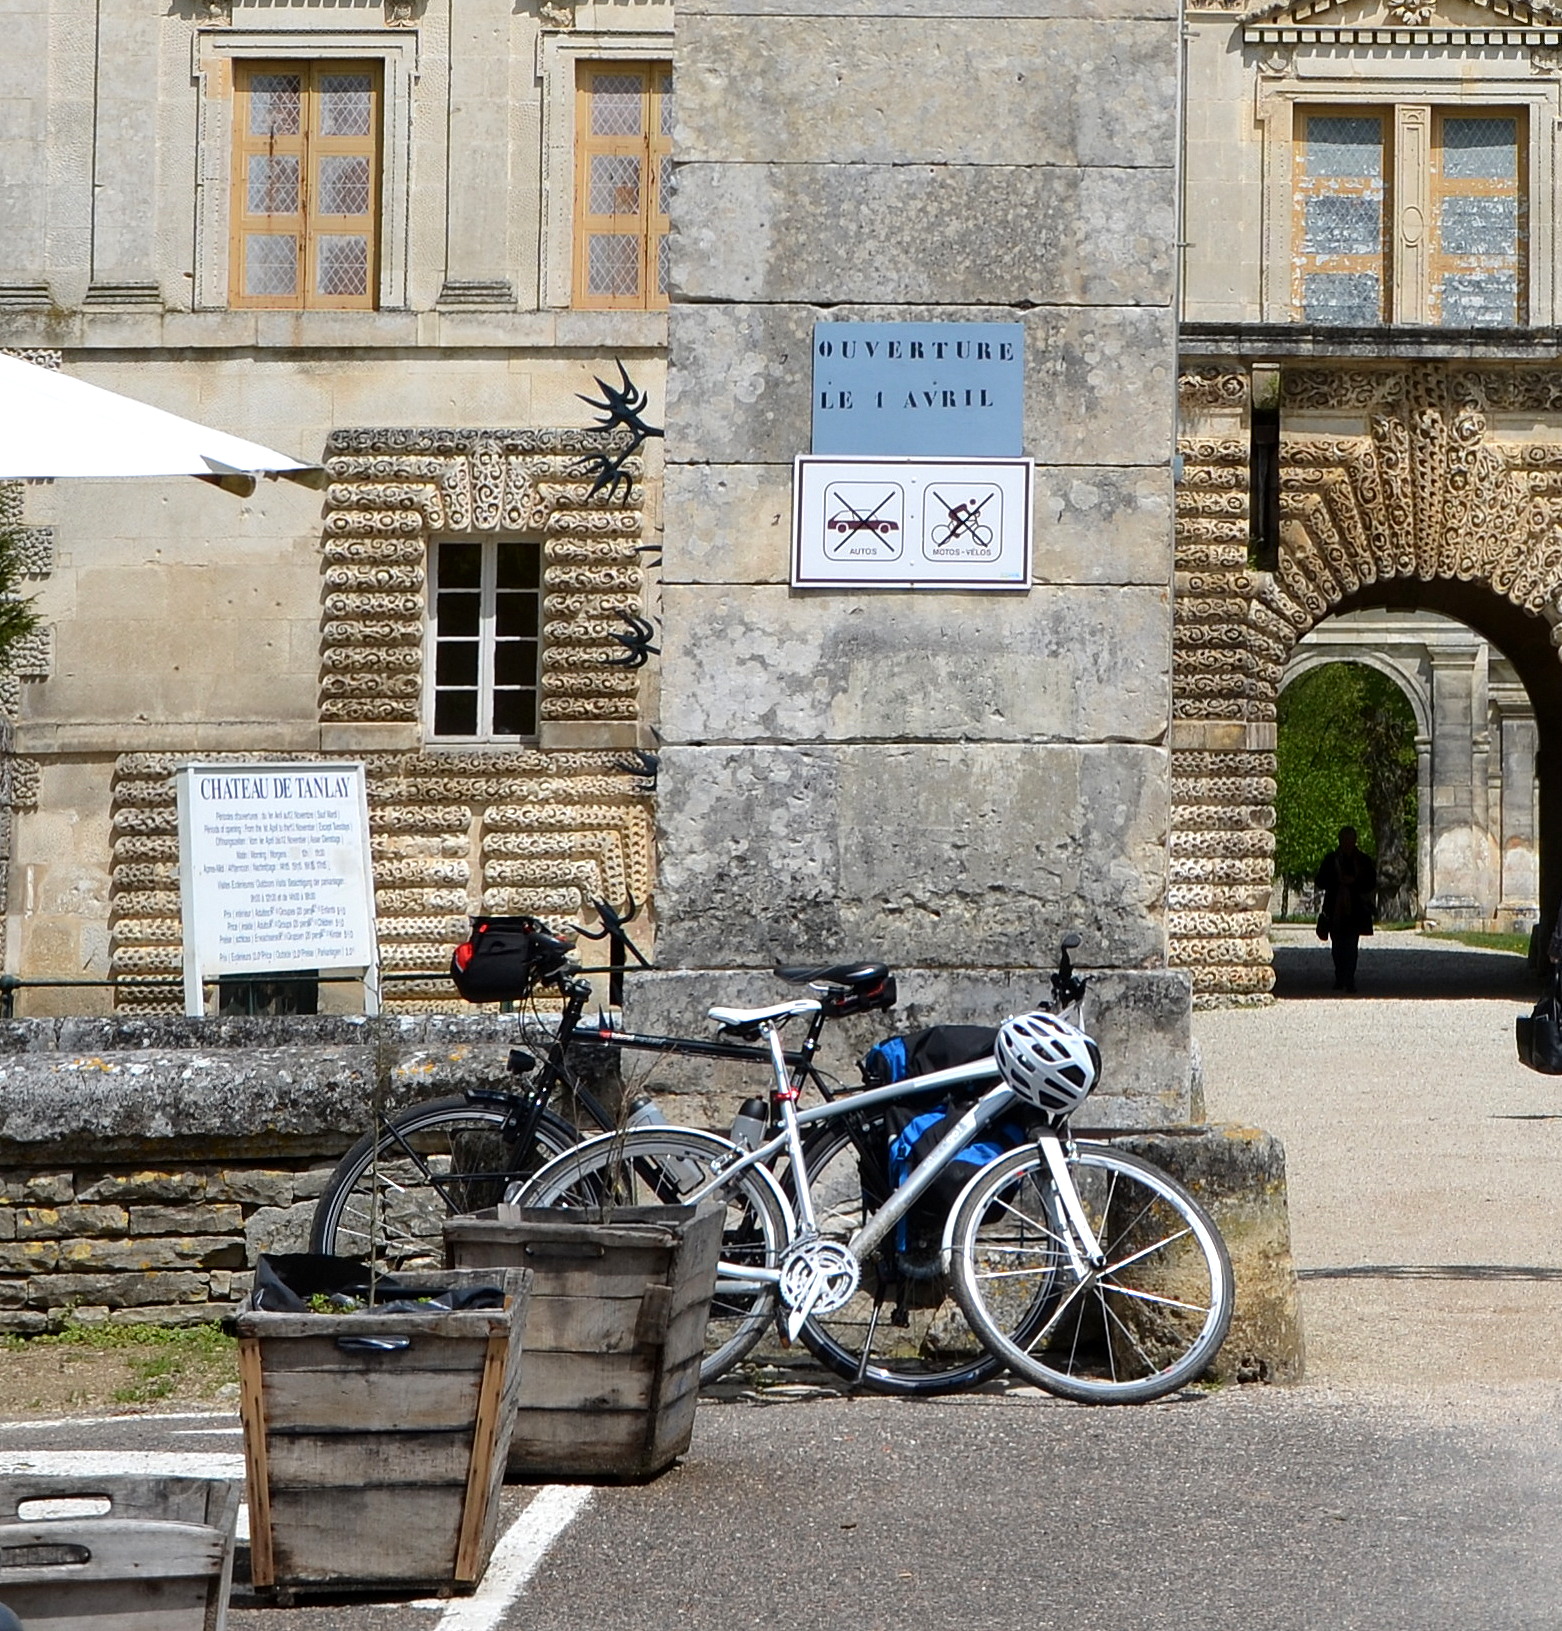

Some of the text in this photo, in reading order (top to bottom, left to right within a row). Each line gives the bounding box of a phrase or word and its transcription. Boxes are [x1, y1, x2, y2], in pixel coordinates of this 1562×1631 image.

[819, 340, 1014, 361] OUVERTURE
[820, 390, 853, 410] LE
[903, 389, 994, 409] AVRIL
[849, 547, 877, 556] AUTOS
[273, 777, 292, 799] DE
[295, 776, 351, 799] TANLAY
